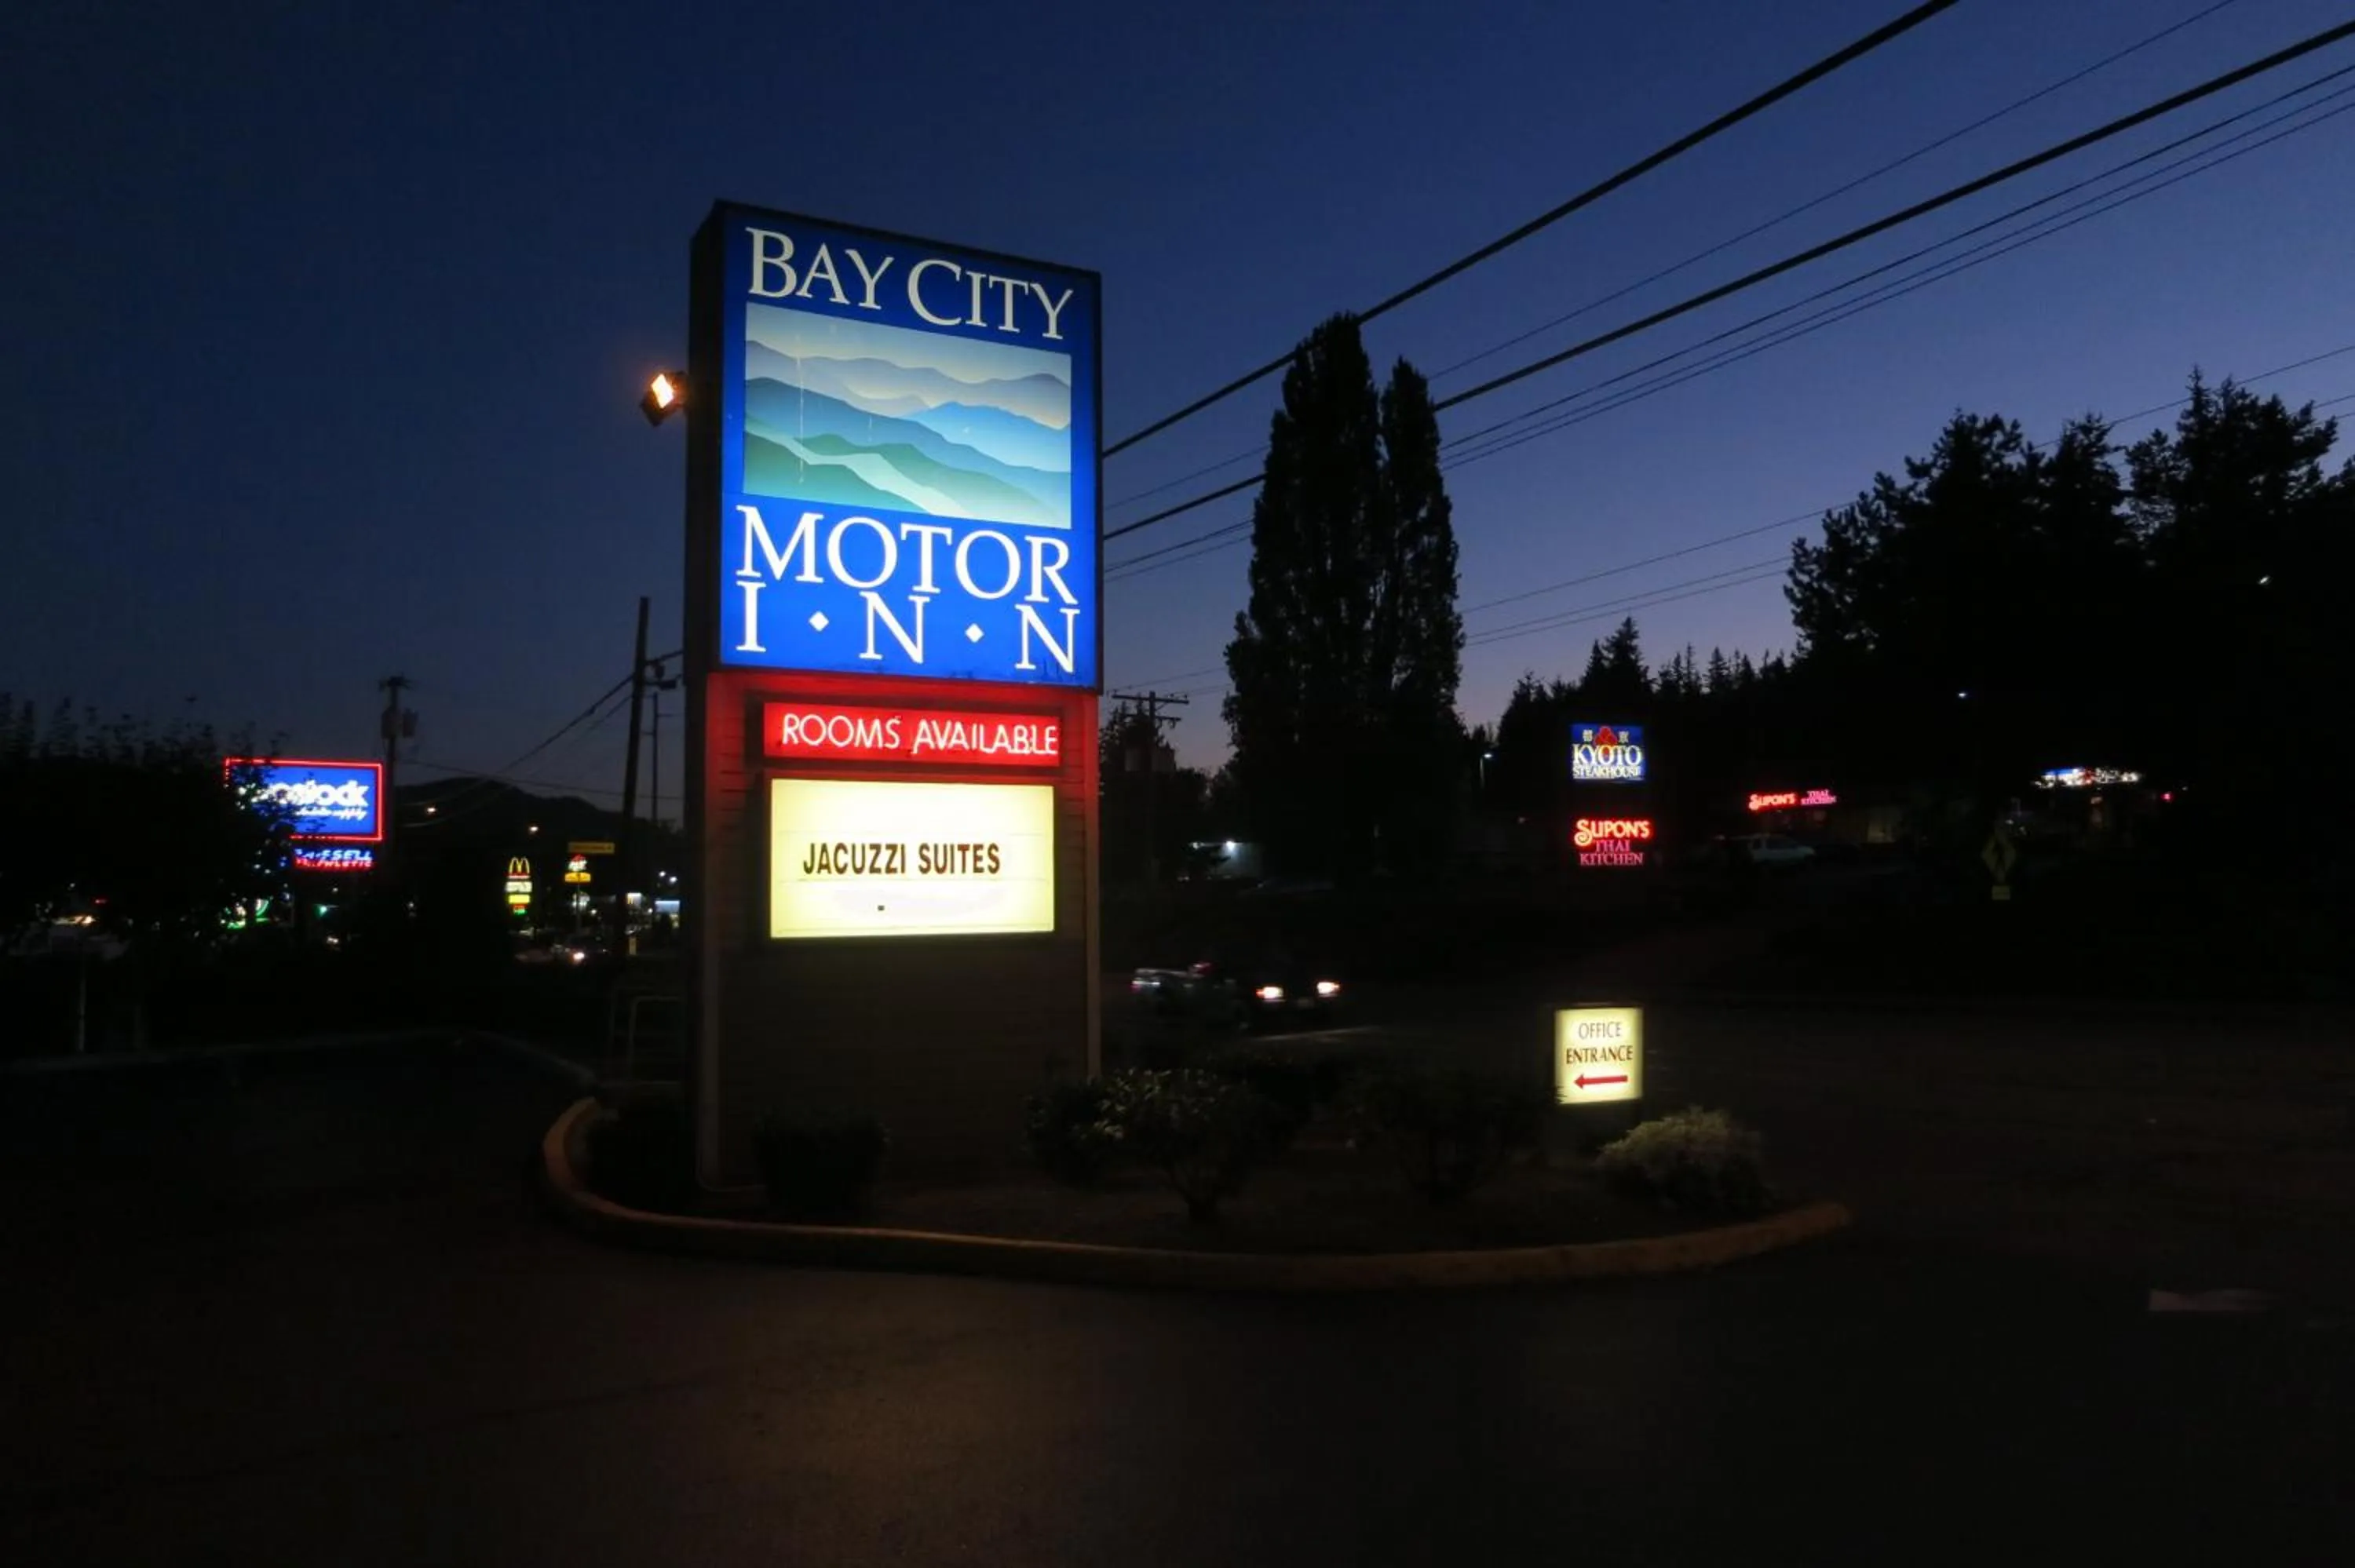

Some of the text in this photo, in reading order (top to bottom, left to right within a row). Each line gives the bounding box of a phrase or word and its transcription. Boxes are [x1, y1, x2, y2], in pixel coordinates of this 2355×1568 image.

[745, 227, 1074, 340] BAY CITY
[736, 504, 1079, 605] MOTOR
[781, 713, 1059, 755] ROOMS AVAILABLE
[1572, 744, 1643, 766] KYOTO
[1574, 819, 1651, 847] SUPON'S
[1595, 839, 1631, 852] THAI
[803, 842, 1002, 875] JACUZZI SUITES
[1579, 852, 1644, 866] KITCHEN
[1578, 1020, 1622, 1040] OFFICE
[1565, 1045, 1634, 1065] ENTRANCE
